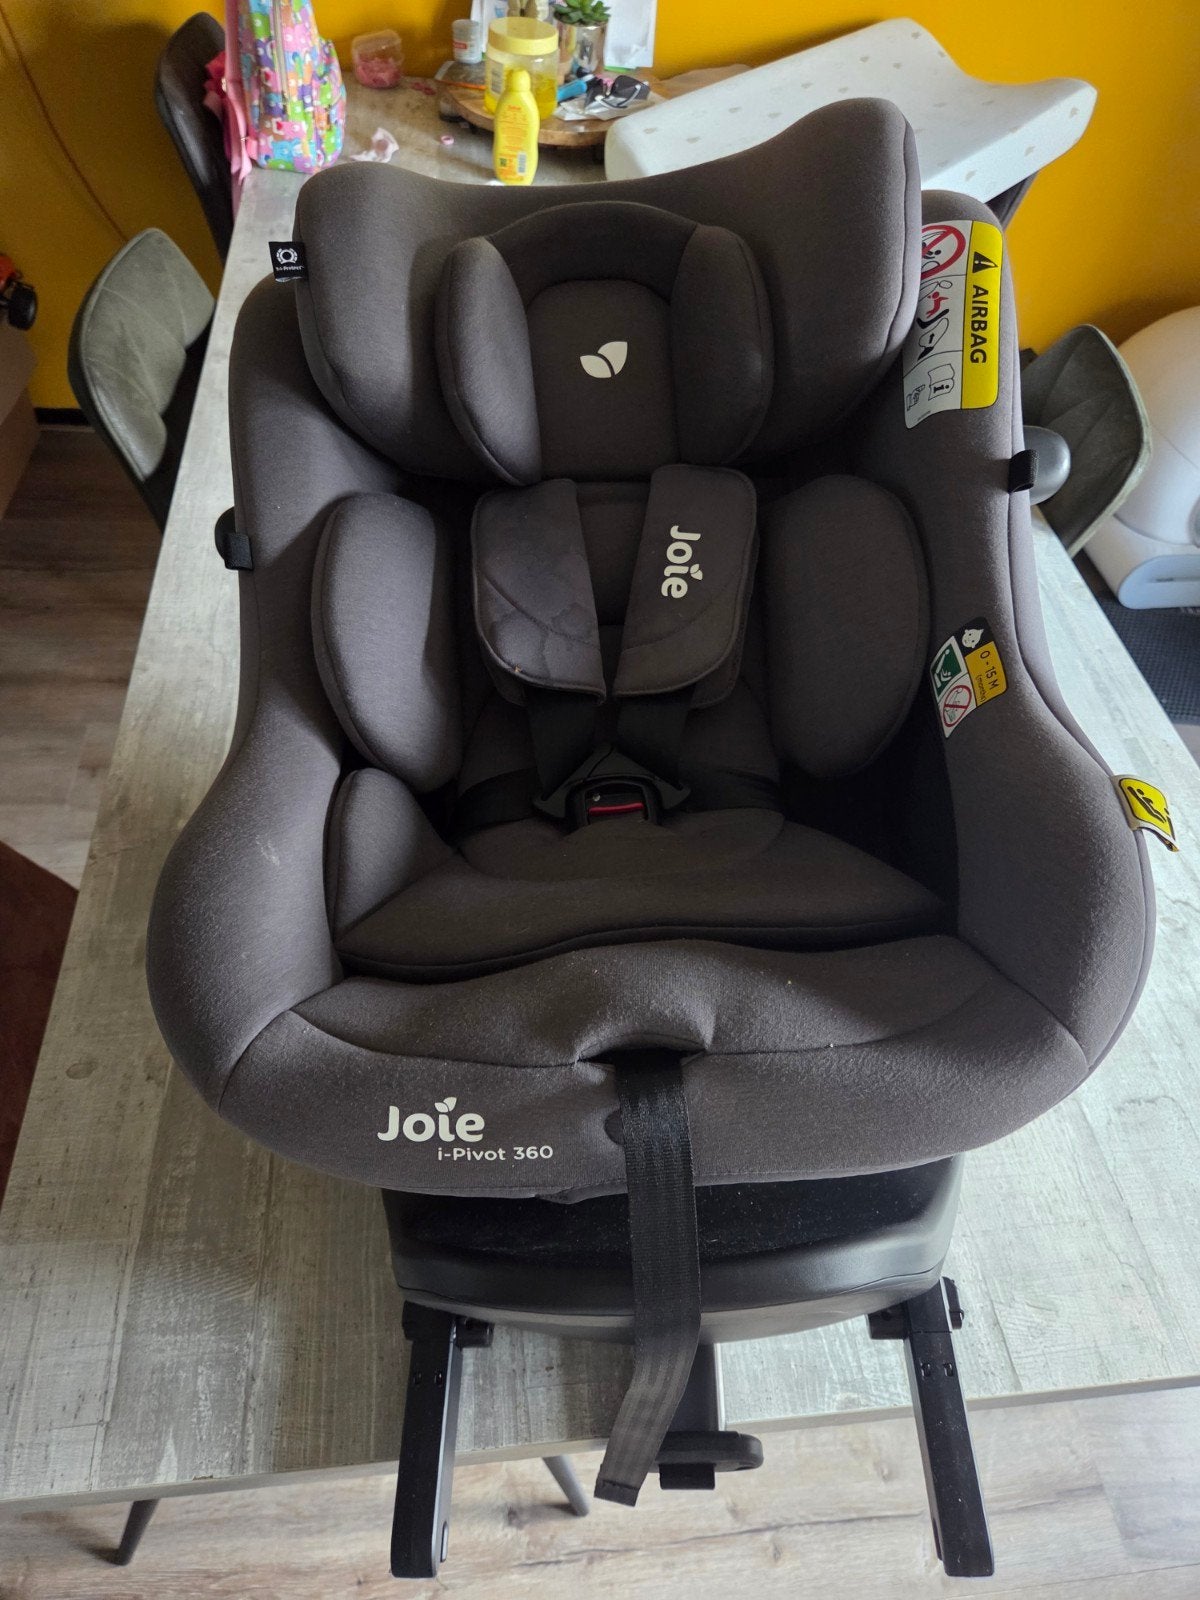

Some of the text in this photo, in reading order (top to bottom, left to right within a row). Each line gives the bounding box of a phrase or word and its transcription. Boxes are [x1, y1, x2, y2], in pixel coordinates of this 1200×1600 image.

[970, 284, 989, 364] AIRBAG
[661, 525, 703, 599] Joie
[980, 650, 990, 659] 0
[986, 666, 997, 679] 15
[988, 679, 999, 690] M
[377, 1096, 485, 1142] Joie
[437, 1145, 554, 1161] i-Pivot 360
